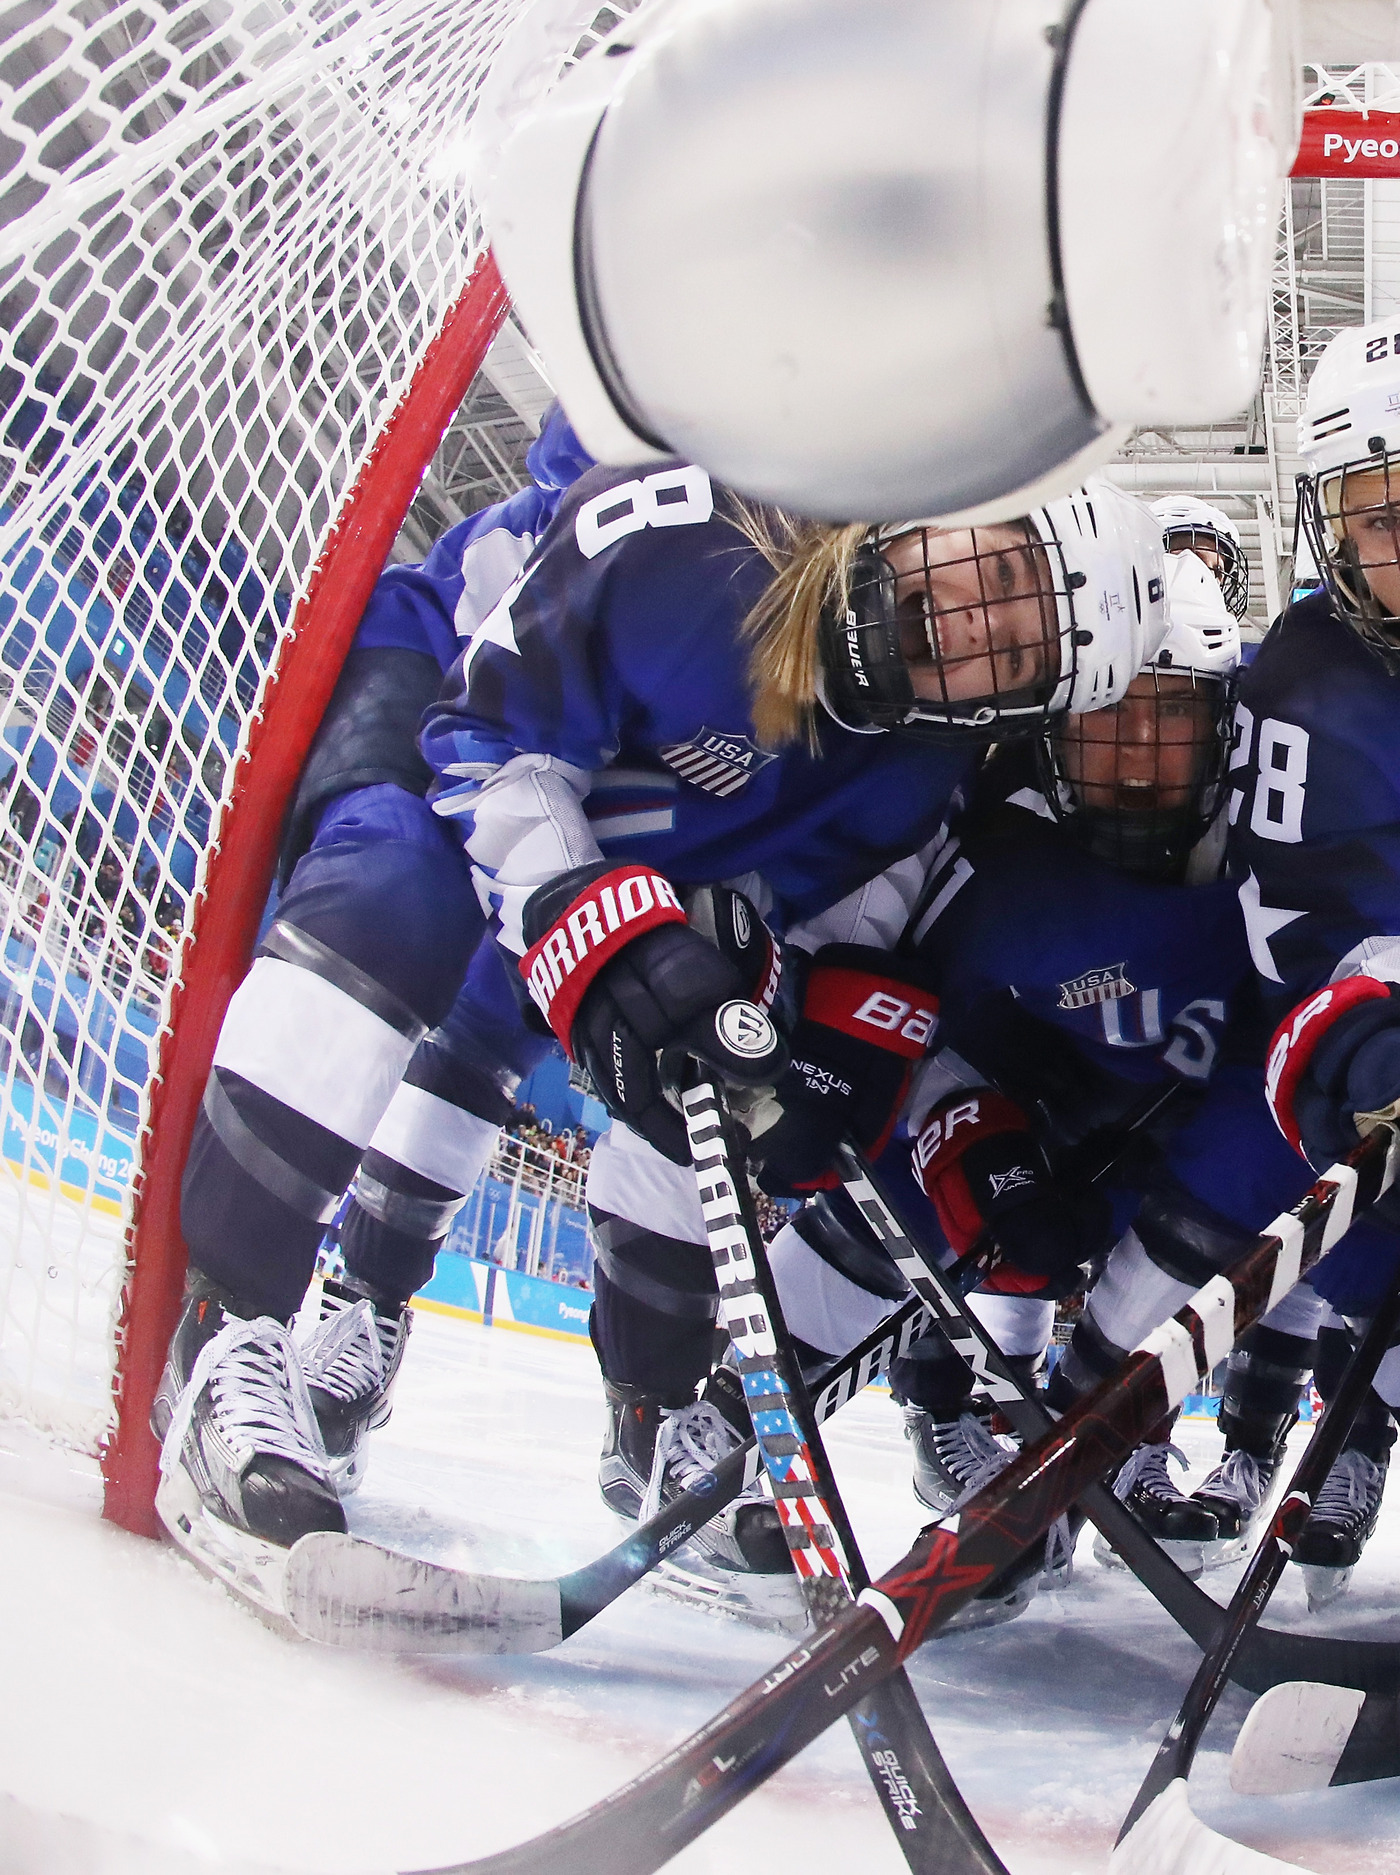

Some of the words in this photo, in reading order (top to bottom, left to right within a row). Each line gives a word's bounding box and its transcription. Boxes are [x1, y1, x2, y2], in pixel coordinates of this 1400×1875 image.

[702, 734, 752, 768] USA
[1072, 971, 1115, 992] USA
[612, 1030, 627, 1103] COVERT
[790, 1058, 853, 1096] NEXUS
[658, 1520, 687, 1546] QUICK
[658, 1523, 692, 1554] STRIKE
[823, 1646, 881, 1698] LITE
[871, 1750, 917, 1831] STRIKE
[878, 1749, 924, 1817] QUICK
